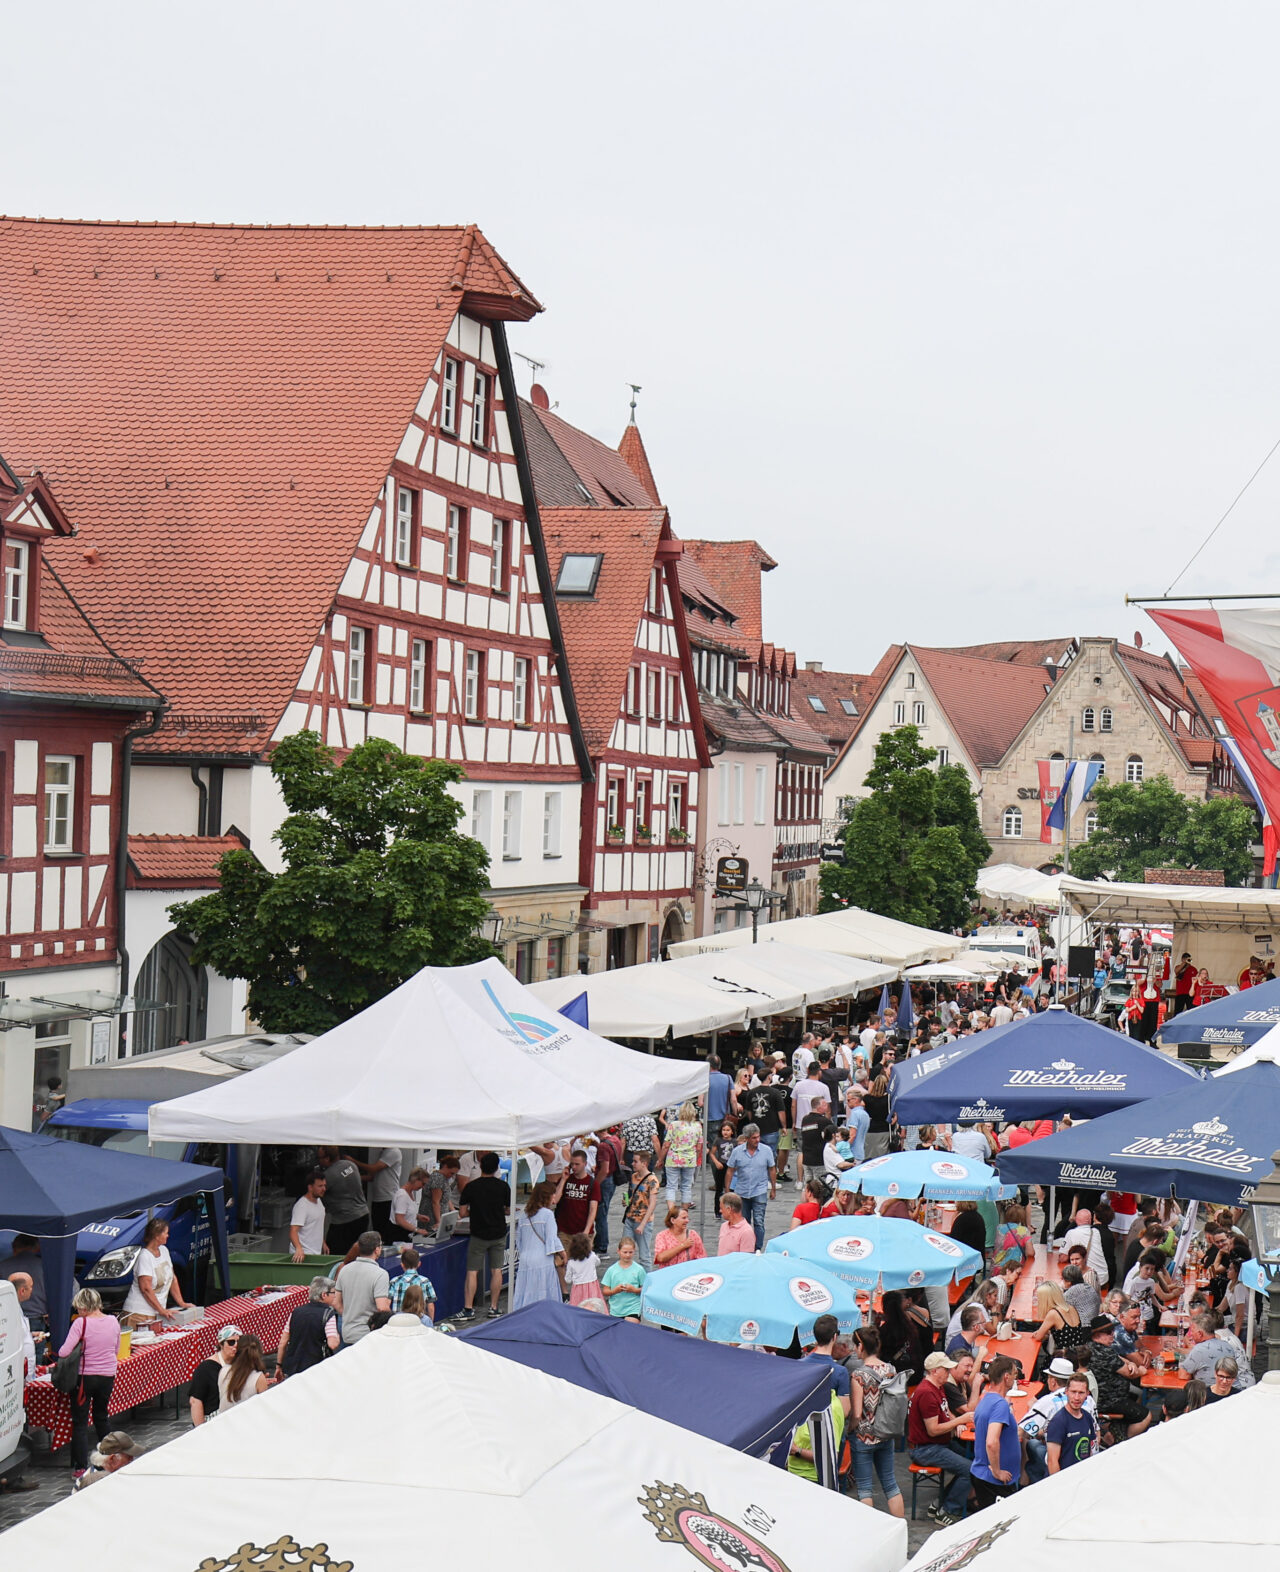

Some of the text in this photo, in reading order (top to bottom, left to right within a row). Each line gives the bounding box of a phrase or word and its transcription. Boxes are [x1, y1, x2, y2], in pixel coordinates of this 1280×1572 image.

[1003, 1068, 1127, 1088] Wiethaler
[957, 1105, 1007, 1120] Wiethaler
[1167, 1132, 1237, 1147] BRAUEREI
[1110, 1136, 1265, 1173] Wiethaler
[1057, 1162, 1117, 1183] Wiethaler
[835, 1244, 865, 1252] FRANKEN
[685, 1282, 710, 1291] FRANKEN
[798, 1289, 823, 1299] FRANKEN
[802, 1294, 827, 1305] BRUNNEN
[646, 1307, 676, 1321] FRANKEN
[741, 1504, 776, 1536] 1672
